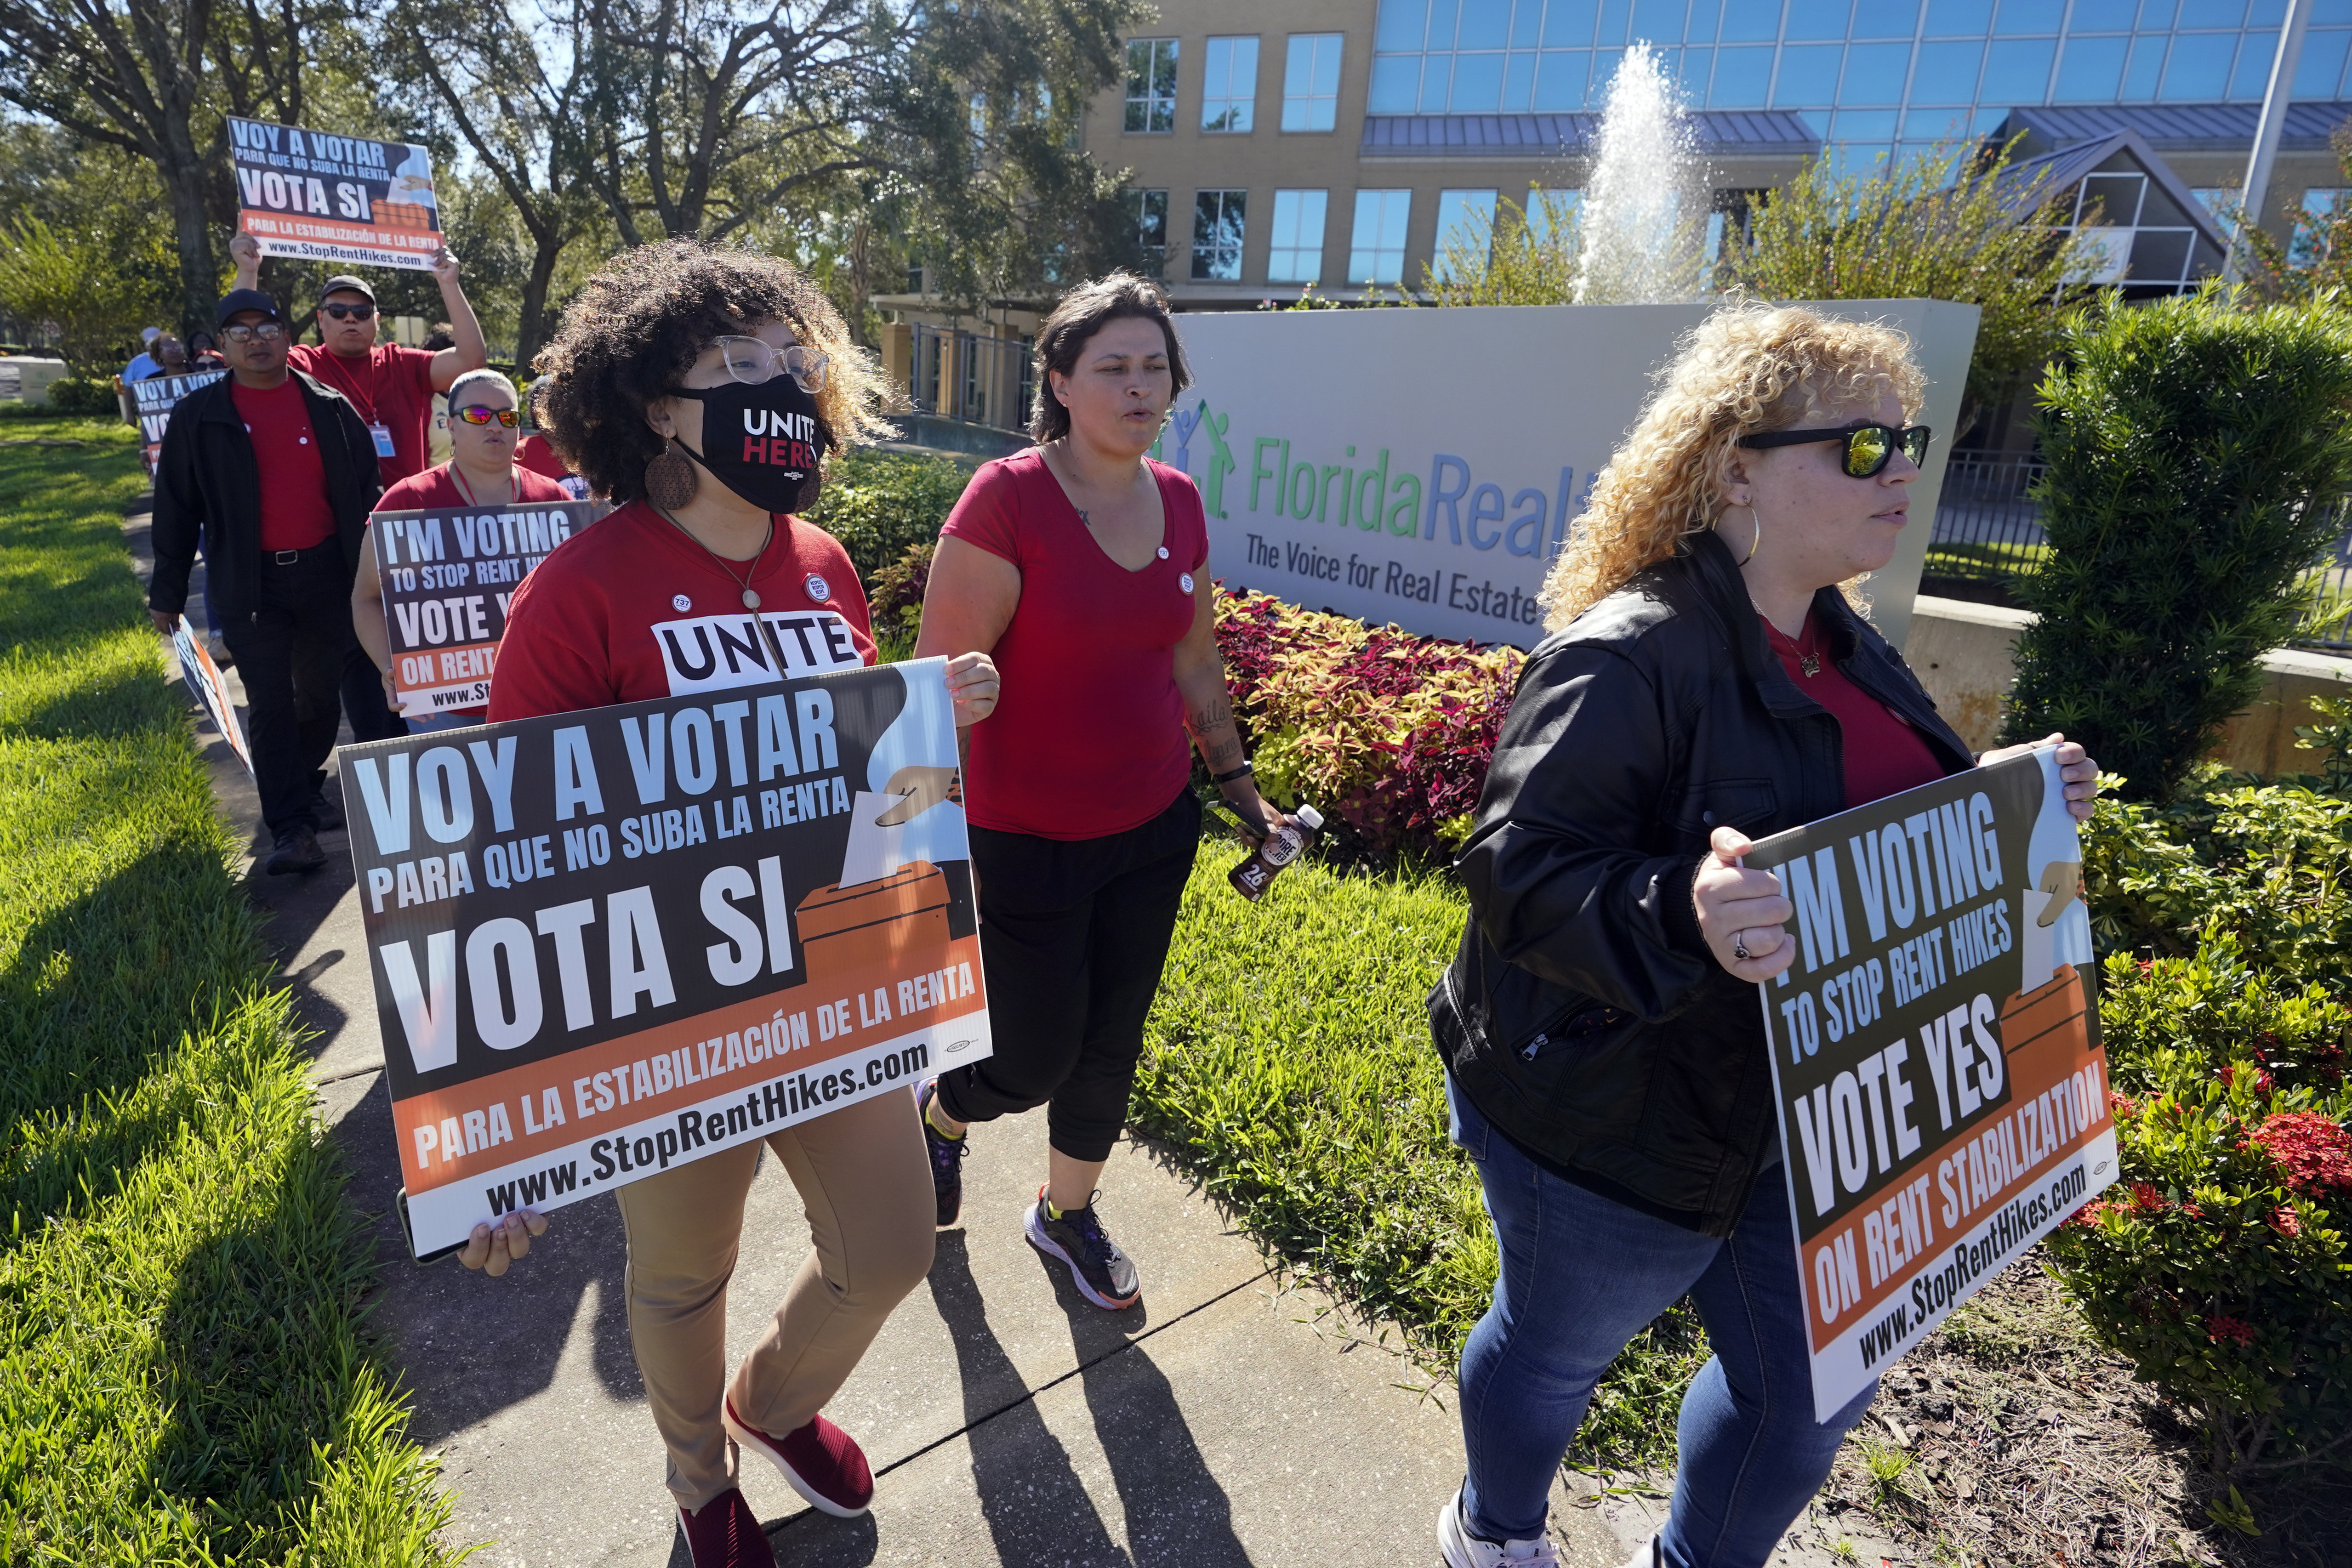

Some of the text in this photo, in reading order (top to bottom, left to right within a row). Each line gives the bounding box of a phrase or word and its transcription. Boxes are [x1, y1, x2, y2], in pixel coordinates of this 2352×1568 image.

[231, 119, 386, 168] VOY A VOTAR
[234, 148, 390, 182] PARA QUE NO SUBA LA RENTA
[238, 168, 370, 220] VOTA SI
[247, 217, 439, 250] PARA LA ESTABILIZACIÓN DE LA RENTA
[269, 243, 421, 266] www.StopRentHikes.com
[133, 380, 167, 402] VOY
[171, 378, 185, 398] A
[138, 401, 159, 412] PARA
[744, 409, 814, 444] UNITE
[382, 510, 571, 564] I'M VOTING
[390, 568, 416, 592] TO
[422, 563, 470, 590] STOP
[475, 559, 520, 584] RENT
[1247, 534, 1537, 625] The Voice for Real Estate
[394, 595, 489, 648] VOTE
[662, 617, 858, 681] UNITE
[402, 647, 494, 685] ON RENT
[354, 687, 839, 858] VOY A VOTAR
[367, 776, 851, 914] PARA QUE NO SUBA LA RENTA
[1851, 791, 2003, 936] VOTING
[380, 855, 794, 1074] VOTA SI
[1781, 898, 2012, 1066] TO STOP RENT HIKES
[413, 962, 975, 1170] PARA LA ESTABILIZACIÓN DE LA RENTA
[485, 1040, 929, 1216] www.StopRentHikes.com
[1794, 993, 2004, 1217] VOTE YES
[1815, 1061, 2105, 1325] ON RENT STABILIZATION
[1858, 1161, 2087, 1370] www.StopRentHikes.com
